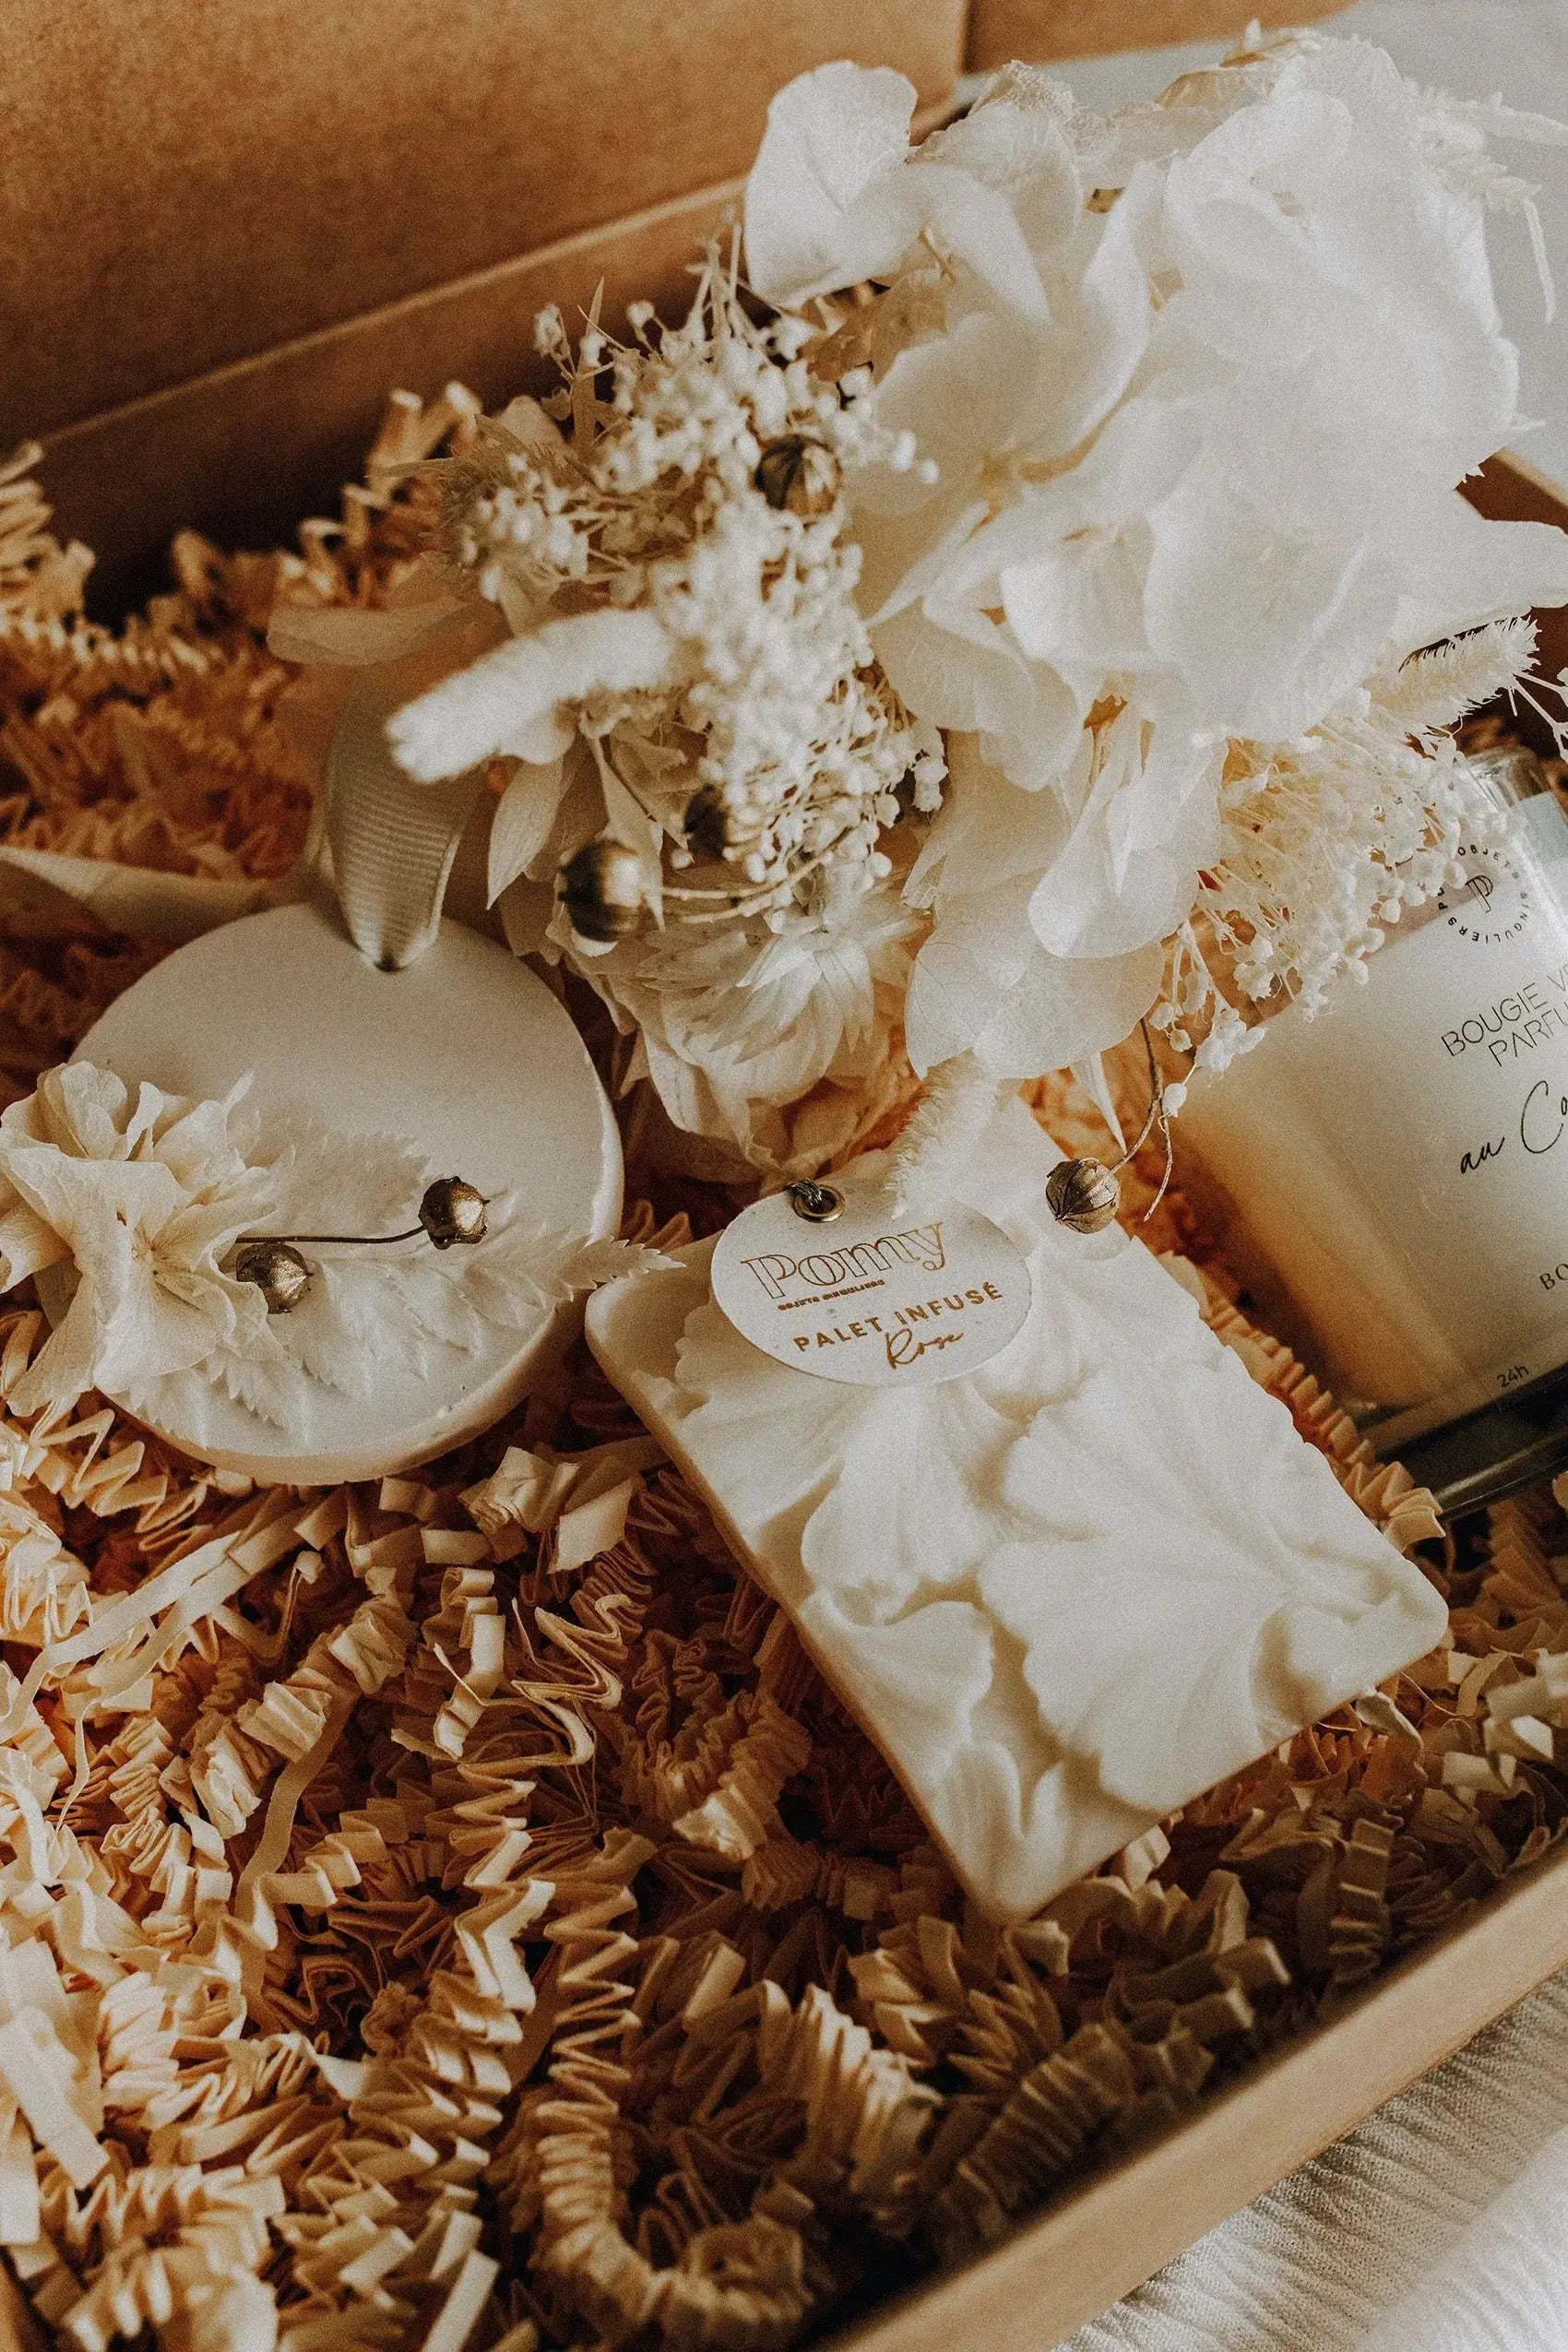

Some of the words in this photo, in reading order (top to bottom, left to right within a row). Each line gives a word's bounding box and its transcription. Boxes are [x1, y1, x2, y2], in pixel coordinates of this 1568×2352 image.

[1441, 982, 1548, 1056] BOUGIE
[1460, 1136, 1505, 1174] au
[740, 1221, 946, 1300] Pomy
[793, 1316, 884, 1352] PALET
[894, 1281, 1004, 1325] INFUSÉ
[1496, 1365, 1529, 1388] 24h
